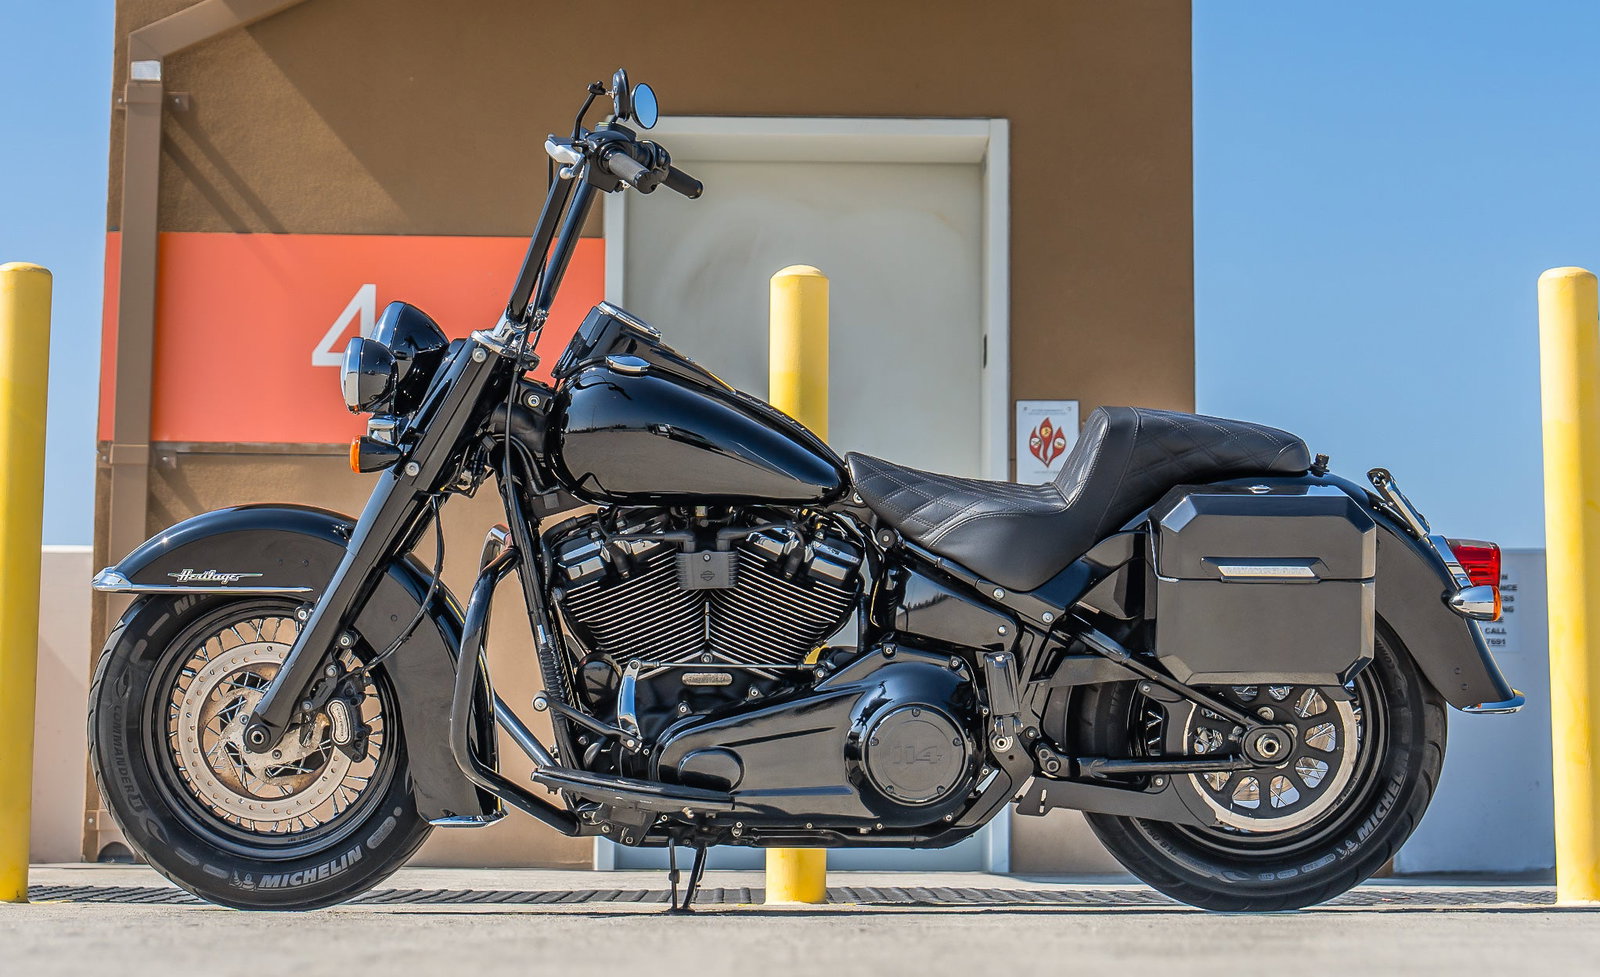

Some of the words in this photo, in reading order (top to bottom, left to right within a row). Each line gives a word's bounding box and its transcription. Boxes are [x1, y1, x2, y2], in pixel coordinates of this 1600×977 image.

[312, 283, 376, 366] 4
[177, 568, 240, 584] Heritage
[1485, 627, 1507, 635] CALL
[112, 704, 135, 794] COMMANDER
[258, 845, 363, 889] MICHELIN
